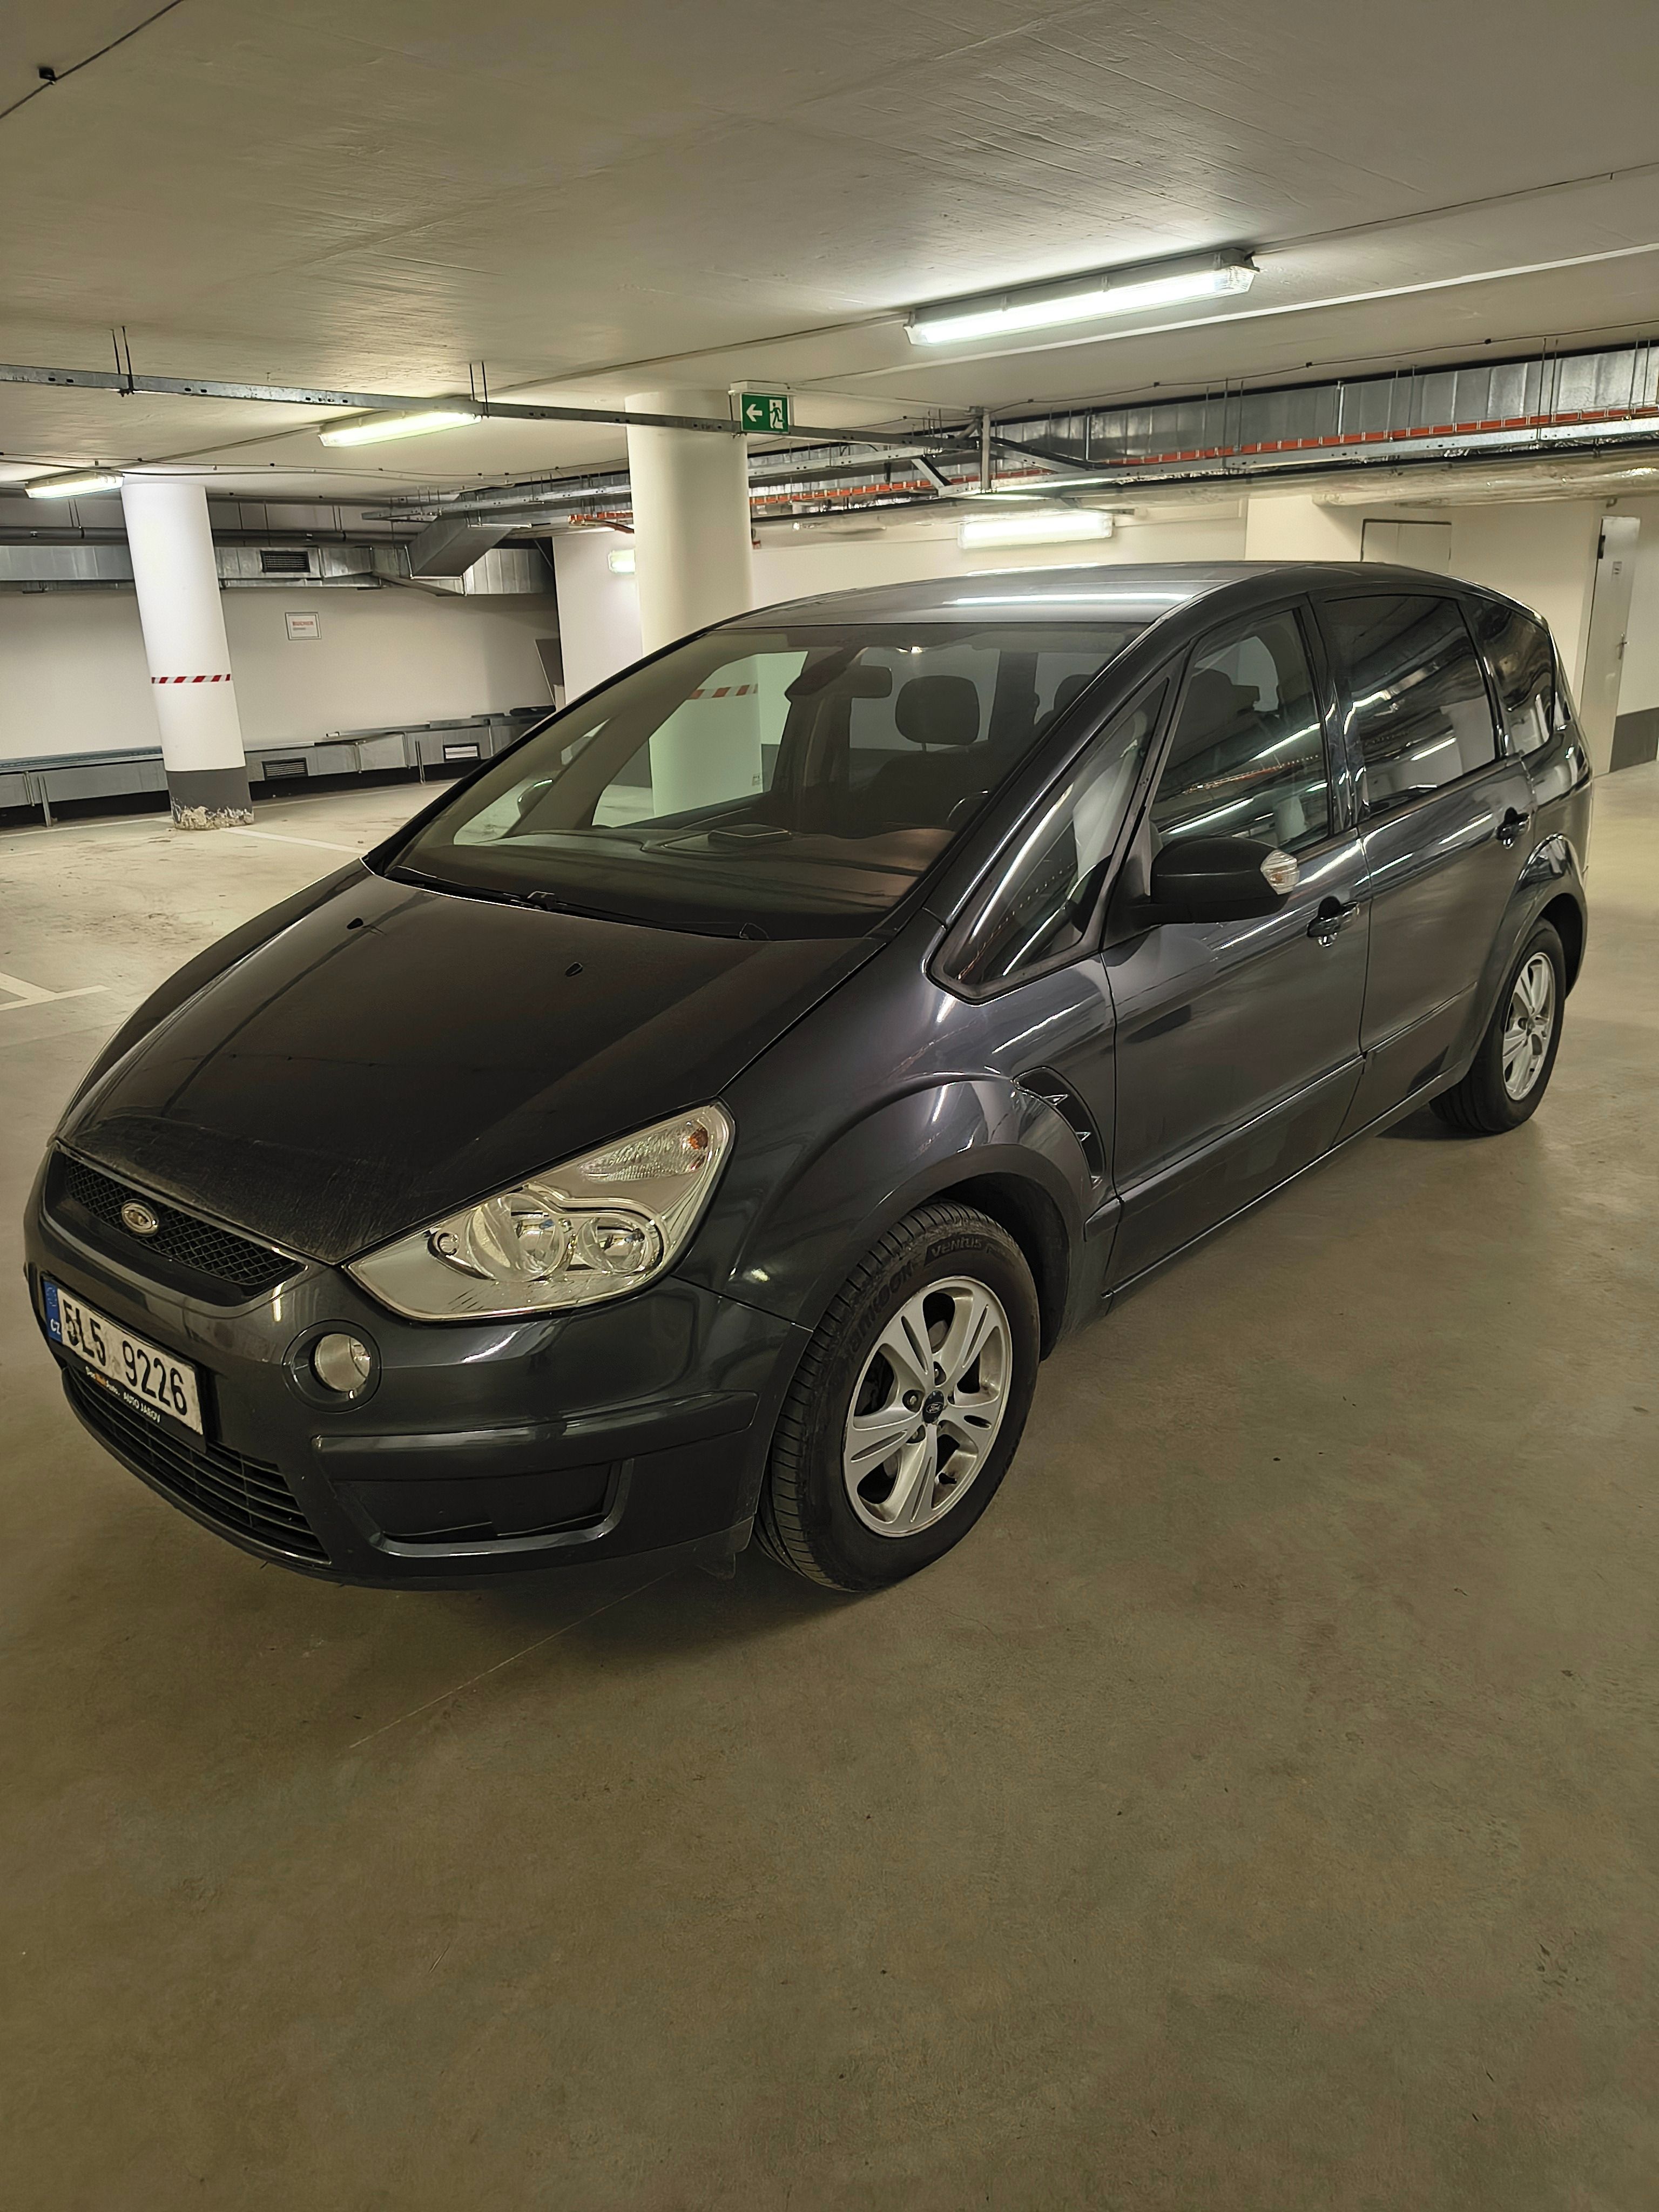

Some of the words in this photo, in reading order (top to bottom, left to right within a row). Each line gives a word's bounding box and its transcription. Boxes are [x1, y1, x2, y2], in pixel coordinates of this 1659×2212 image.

[50, 1318, 60, 1335] CZ
[63, 1299, 106, 1366] 5L5
[122, 1340, 187, 1416] 9226
